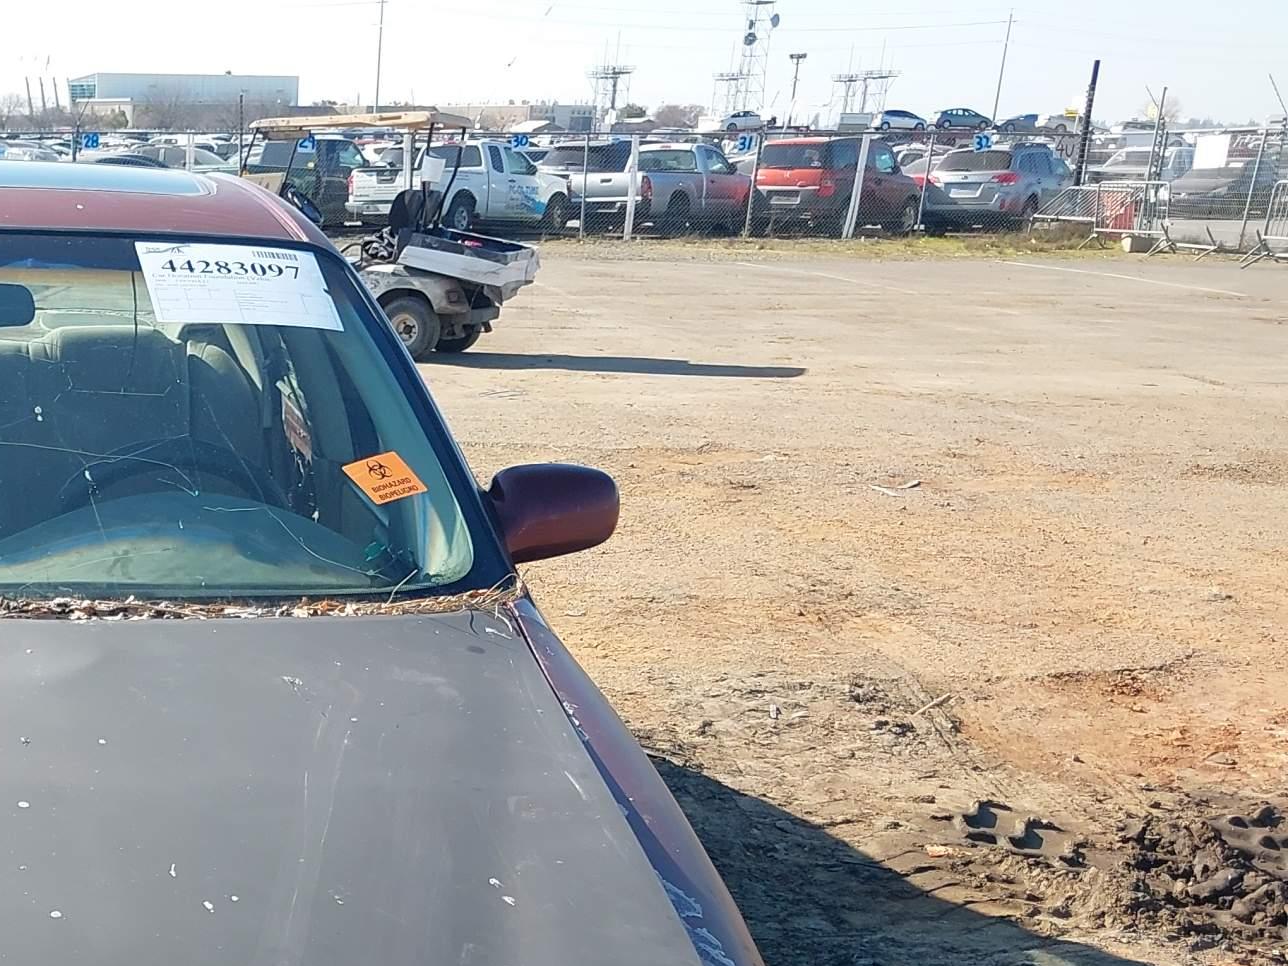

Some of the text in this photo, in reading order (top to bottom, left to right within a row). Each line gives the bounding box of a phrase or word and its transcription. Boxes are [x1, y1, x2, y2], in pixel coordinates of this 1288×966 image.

[84, 134, 99, 148] 28
[513, 135, 528, 148] 30
[738, 135, 753, 151] 31
[975, 135, 992, 151] 32
[161, 259, 299, 280] 44283097
[372, 477, 412, 493] BIOHAZARD
